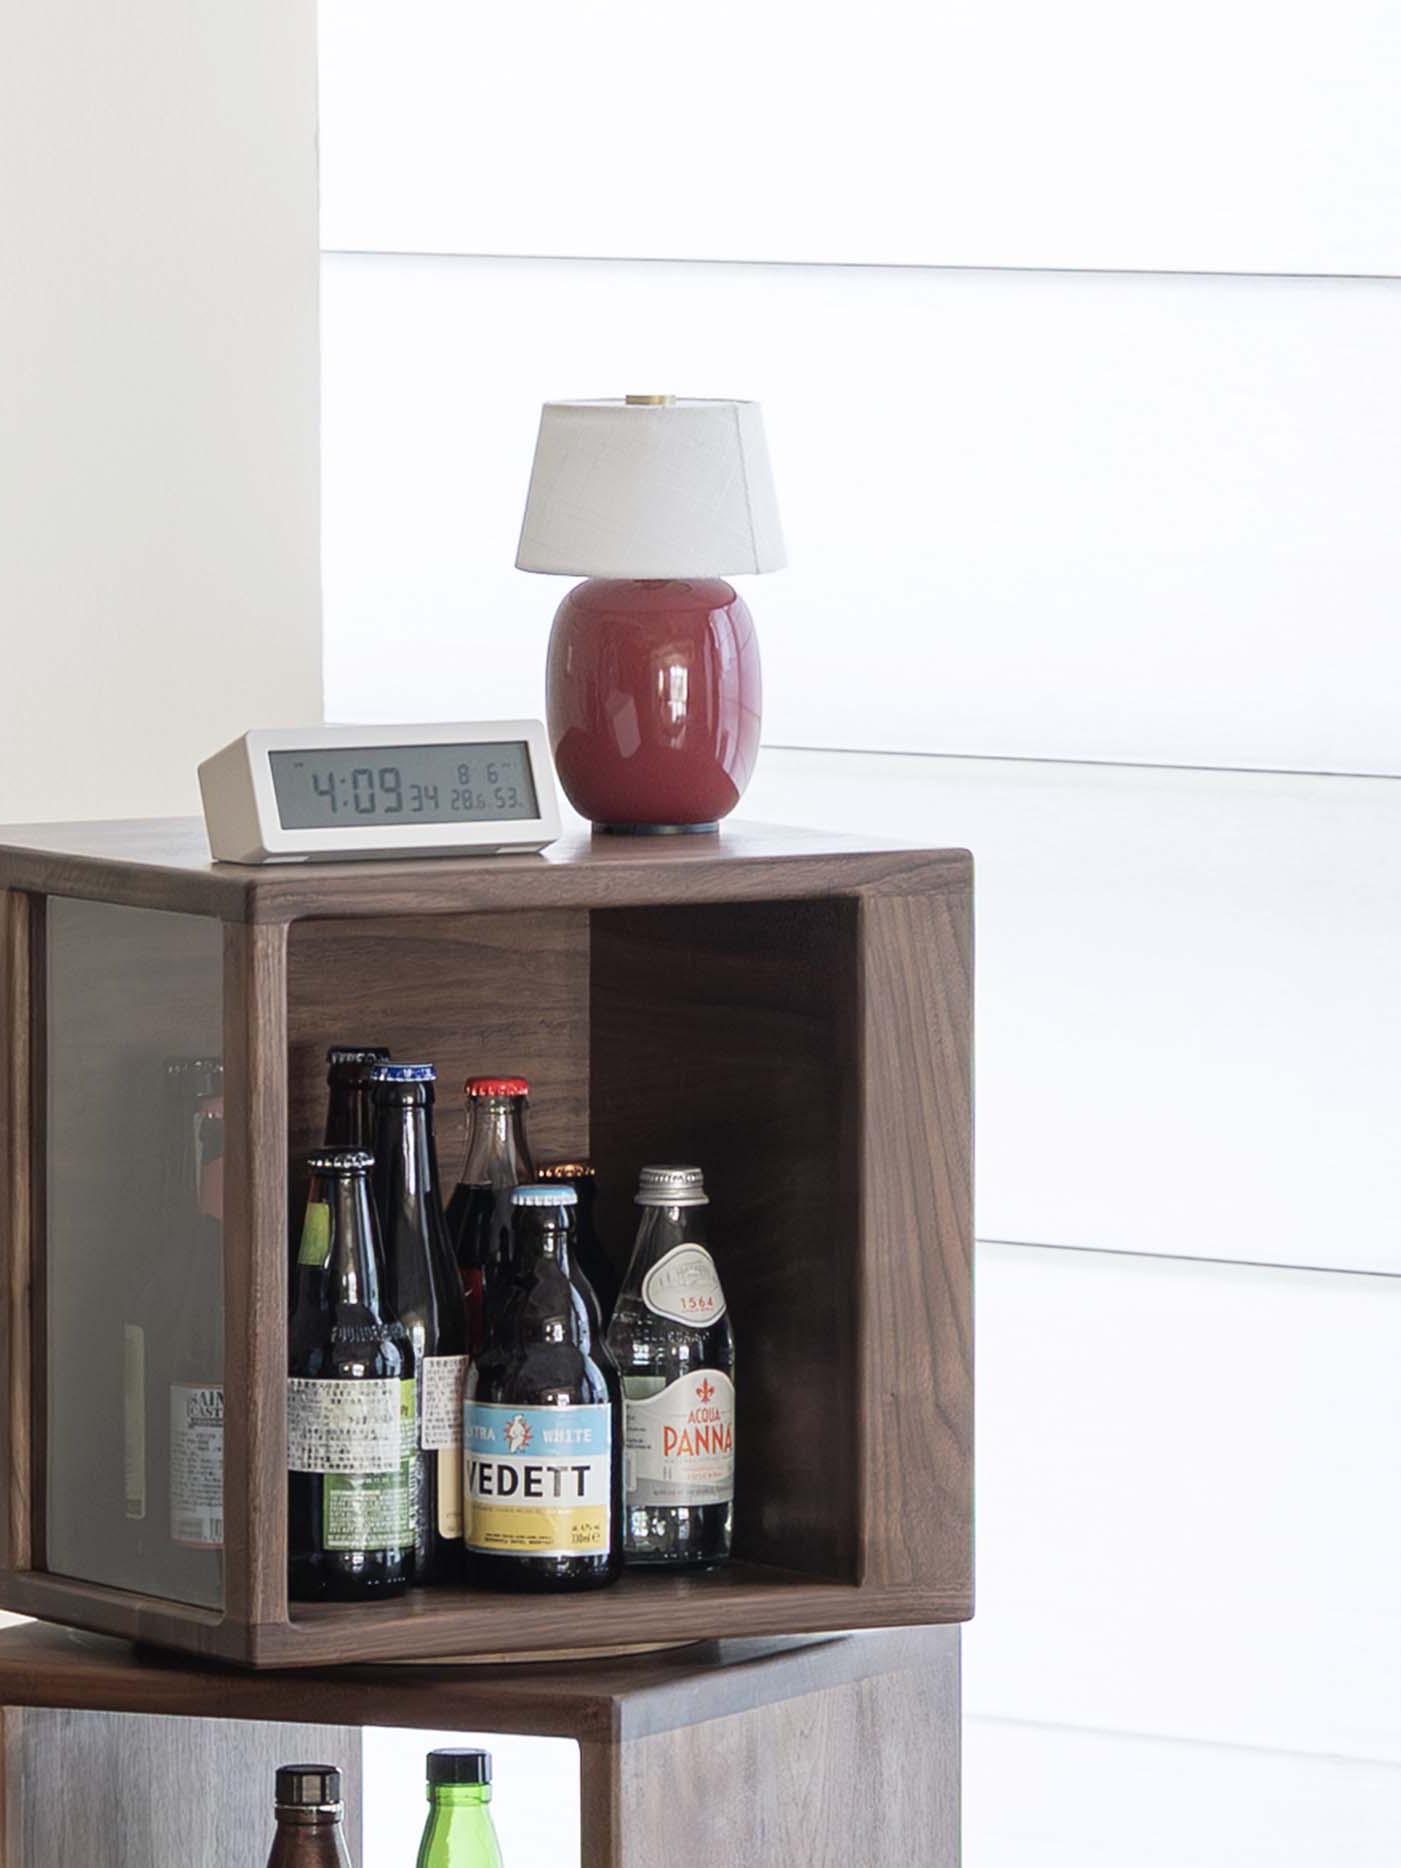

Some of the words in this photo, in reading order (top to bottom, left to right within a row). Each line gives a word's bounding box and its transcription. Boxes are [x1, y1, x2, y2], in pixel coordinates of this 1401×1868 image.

[311, 767, 403, 815] 4:09
[409, 784, 440, 813] 34
[680, 1296, 714, 1309] 1564
[687, 1407, 721, 1424] ACQUA
[542, 1427, 593, 1444] WHITE
[663, 1423, 732, 1457] PANNA
